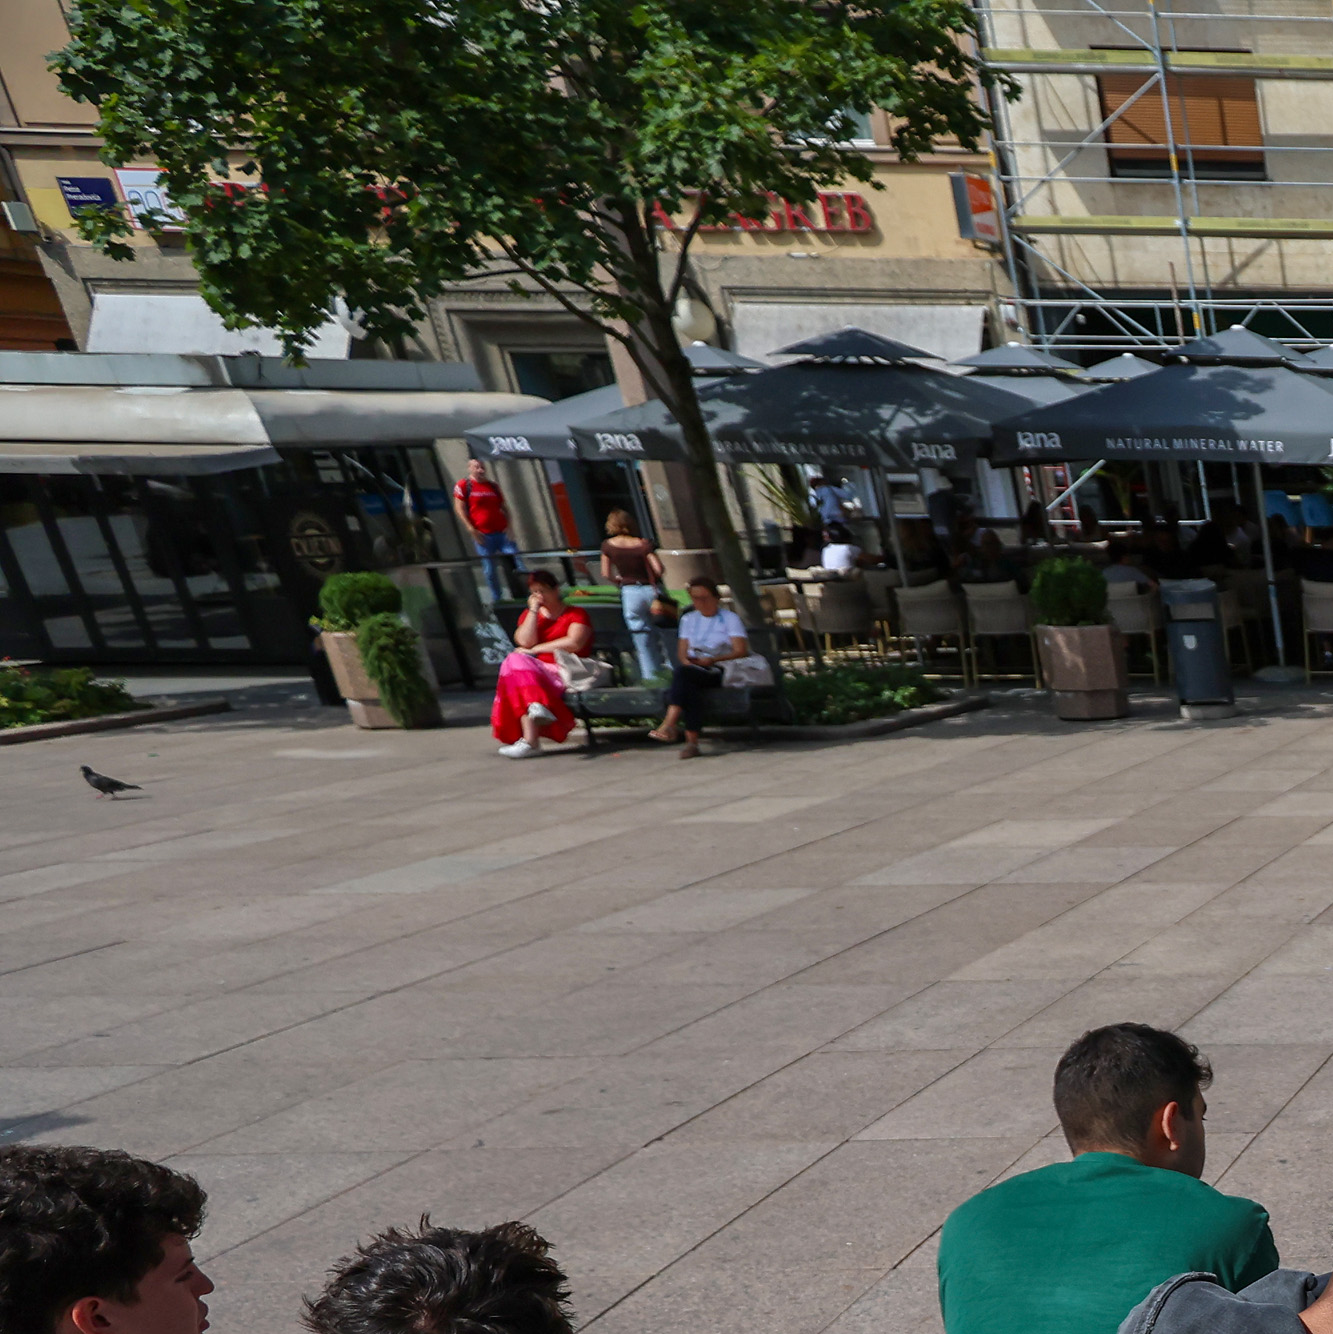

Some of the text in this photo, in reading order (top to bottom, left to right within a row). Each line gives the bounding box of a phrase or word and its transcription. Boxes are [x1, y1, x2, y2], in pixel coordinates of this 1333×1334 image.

[1105, 437, 1285, 452] NATURAL MINERAL WATER
